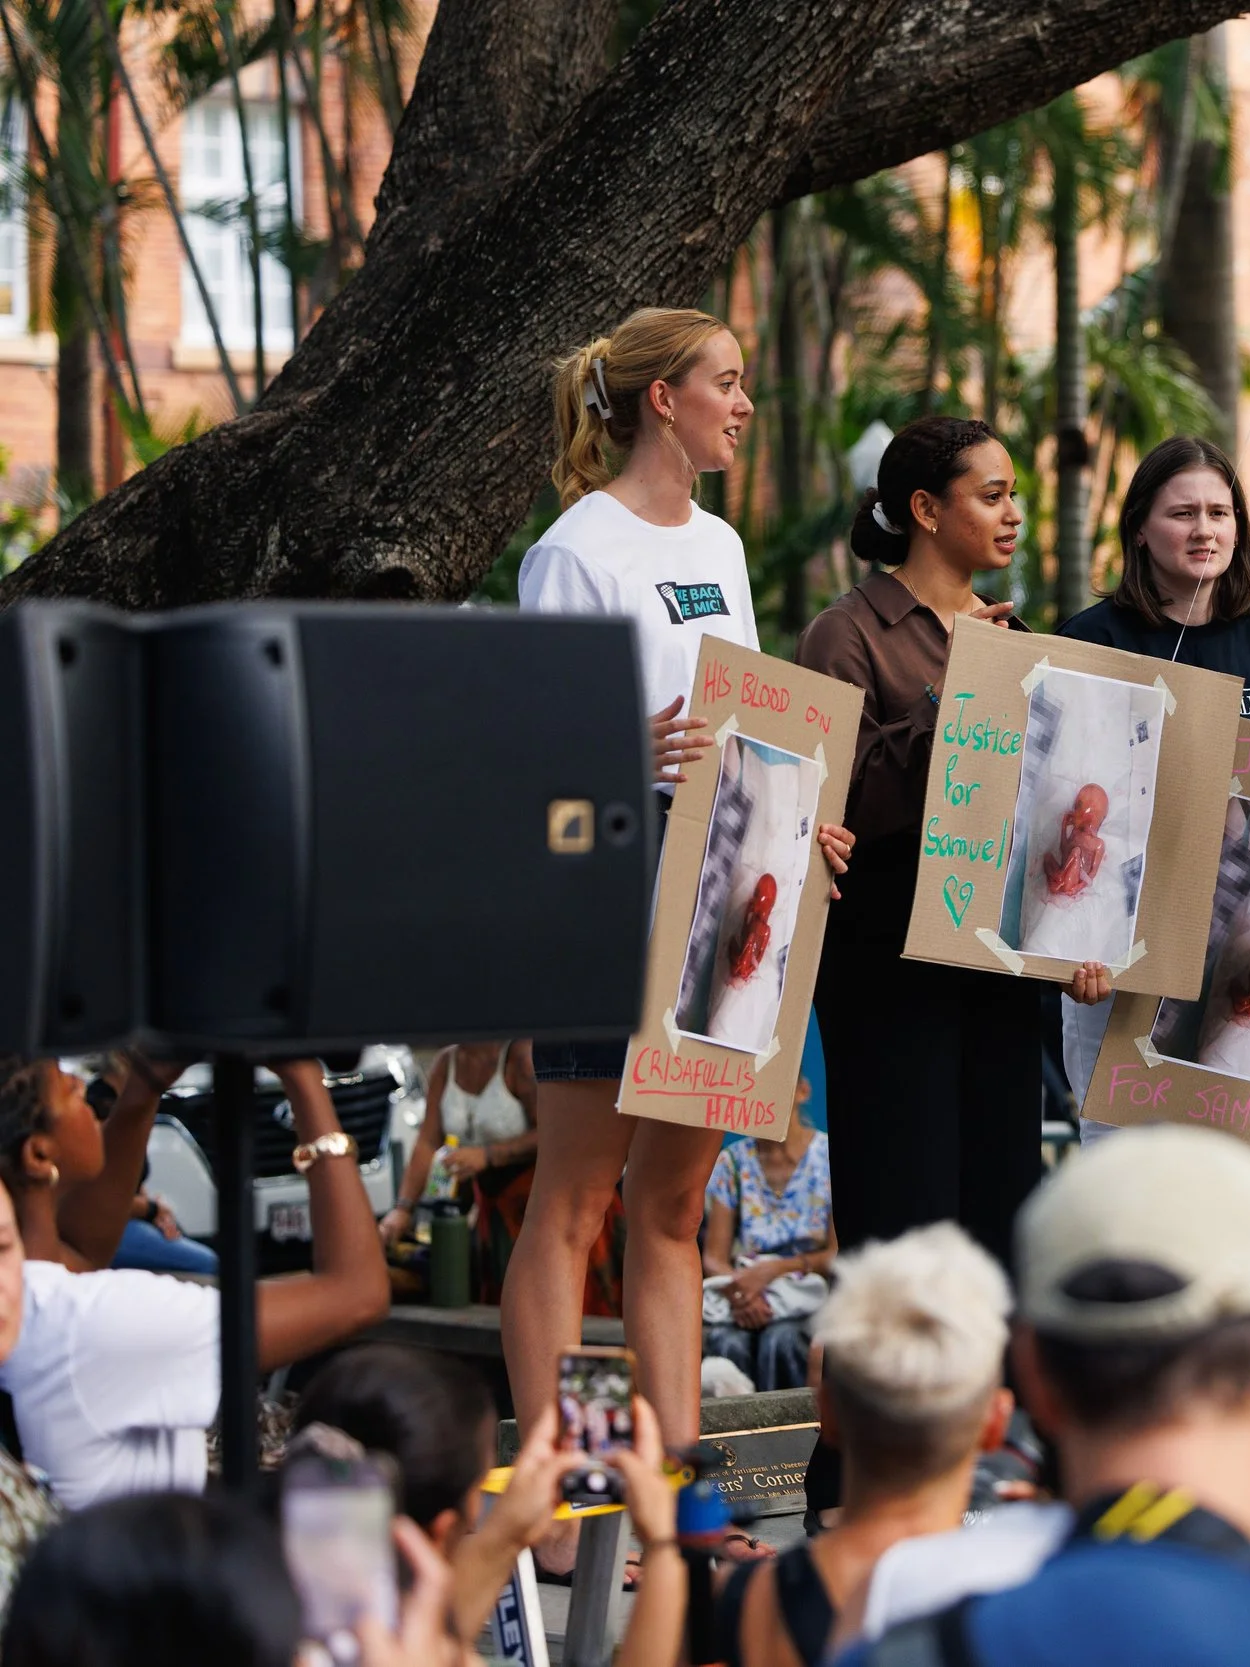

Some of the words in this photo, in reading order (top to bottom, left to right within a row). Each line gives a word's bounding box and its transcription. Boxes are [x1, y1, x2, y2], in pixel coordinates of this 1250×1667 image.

[689, 586, 722, 601] BACK
[693, 599, 721, 615] MIC!
[703, 658, 731, 705] HIS
[741, 672, 790, 712] BLOOD
[805, 706, 832, 735] ON
[943, 692, 1022, 756] Justice
[924, 815, 1008, 871] Samuel
[1107, 1063, 1172, 1107] FOR
[705, 1095, 776, 1130] HANDS
[732, 1466, 769, 1475] Parliament
